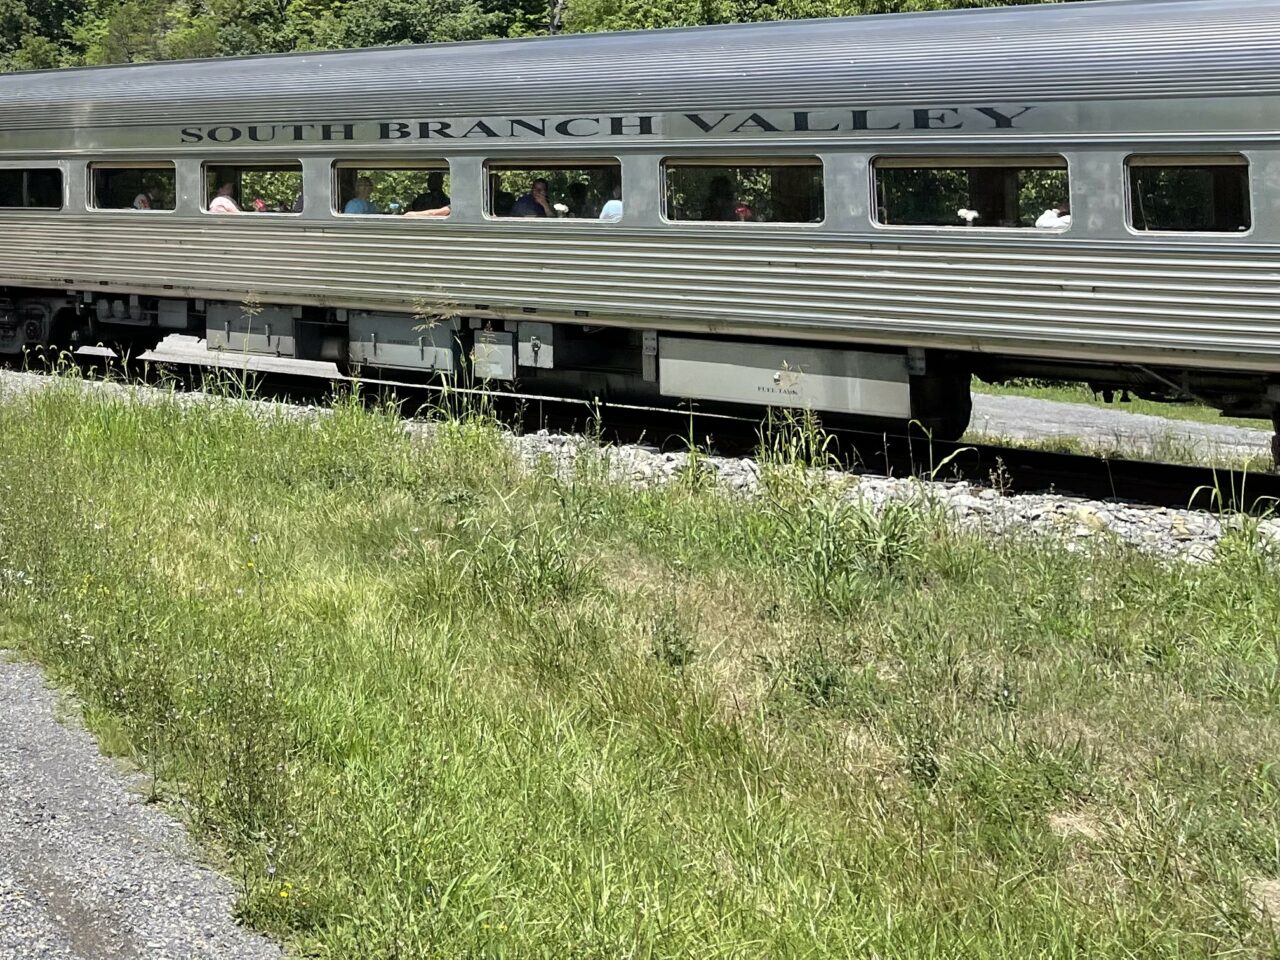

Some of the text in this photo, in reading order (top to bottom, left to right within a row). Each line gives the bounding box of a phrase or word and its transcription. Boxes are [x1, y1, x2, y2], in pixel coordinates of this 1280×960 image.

[181, 106, 1038, 143] SOUTH BRANCH VALLEY
